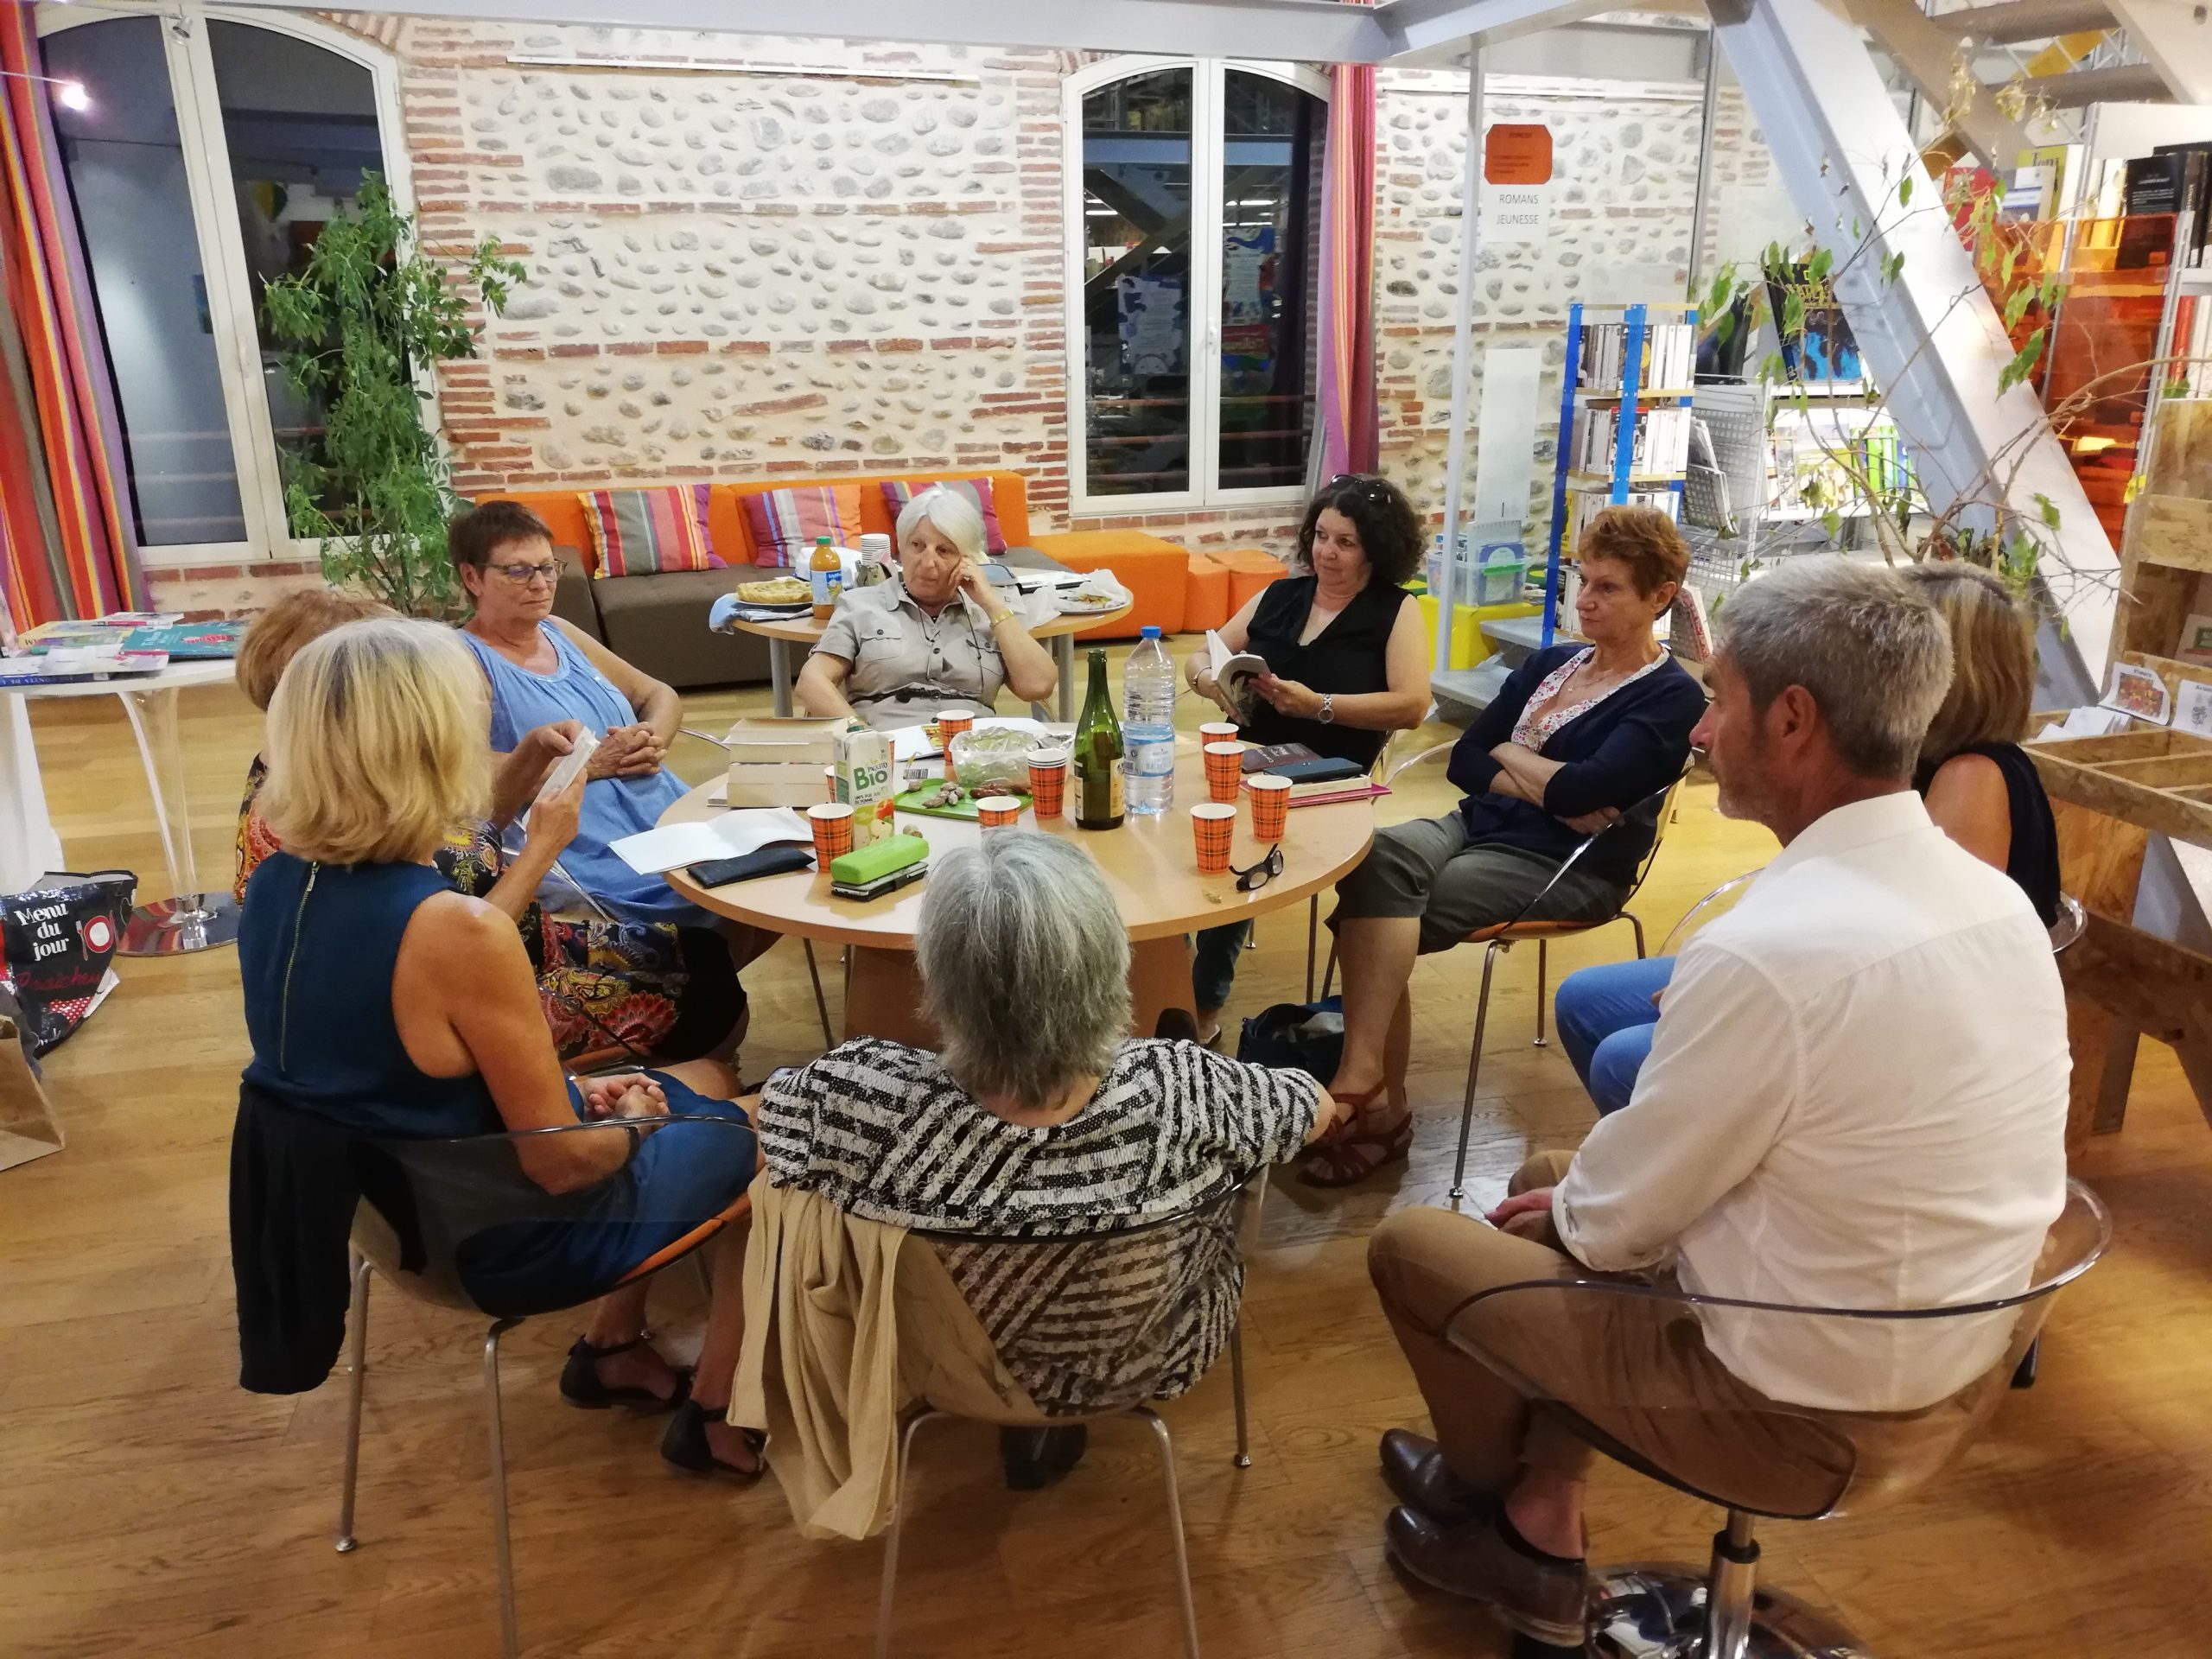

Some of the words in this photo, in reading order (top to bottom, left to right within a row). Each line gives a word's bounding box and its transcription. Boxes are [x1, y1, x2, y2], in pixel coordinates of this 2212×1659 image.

[1499, 194, 1539, 205] ROMANS
[1496, 214, 1539, 225] JEUNESSE
[14, 903, 69, 926] Menu
[36, 922, 62, 939] du
[32, 938, 69, 961] jour
